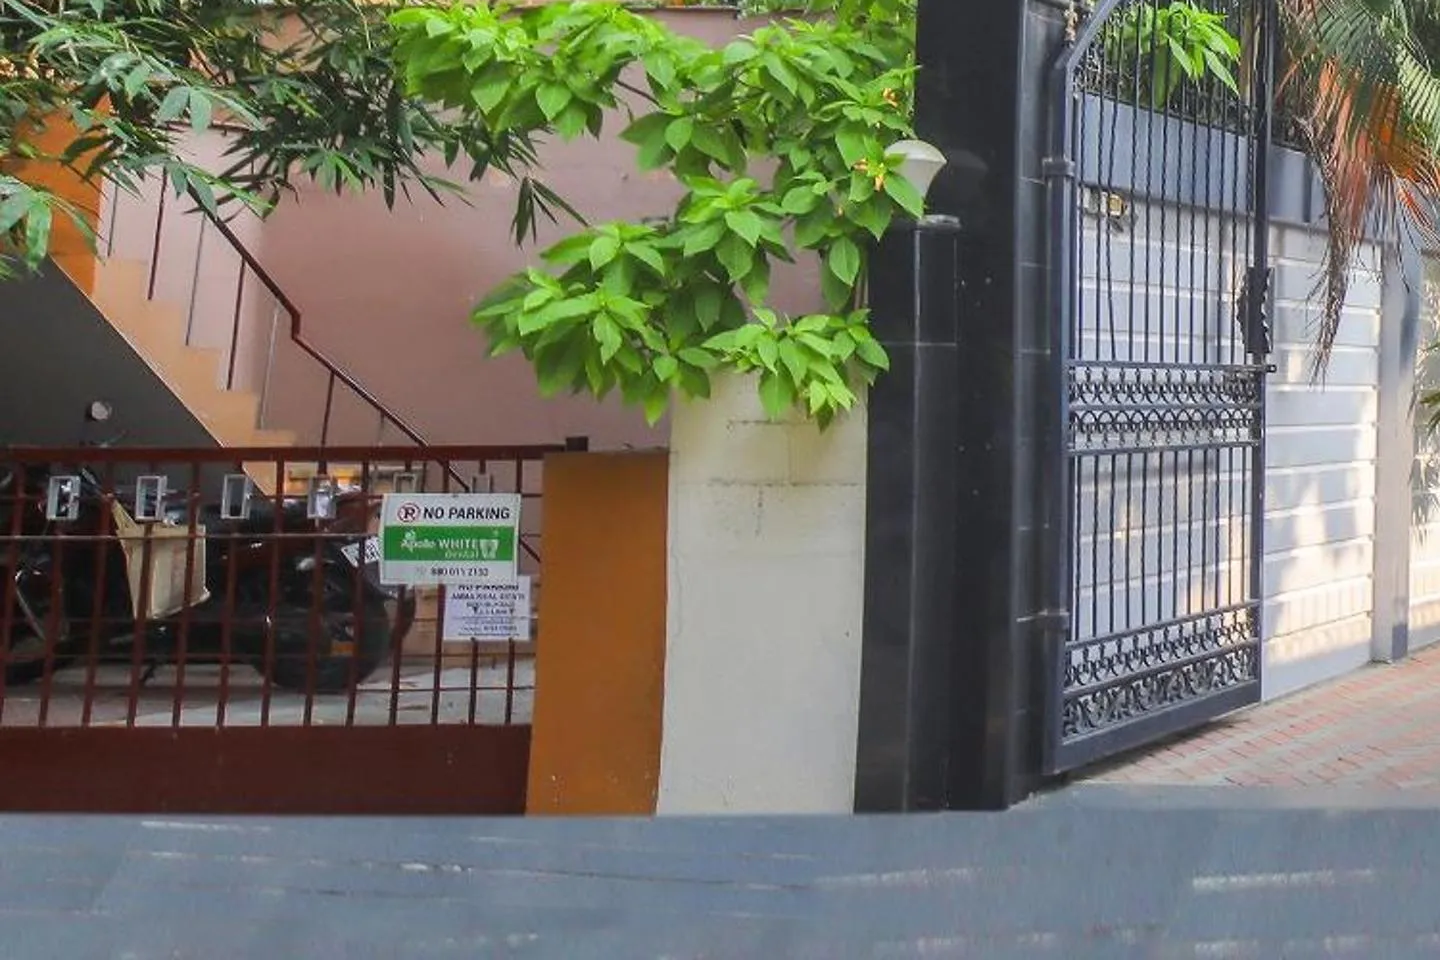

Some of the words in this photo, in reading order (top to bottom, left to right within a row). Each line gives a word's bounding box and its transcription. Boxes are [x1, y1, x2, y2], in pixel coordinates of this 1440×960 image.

[423, 507, 445, 519] NO
[448, 507, 510, 519] PARKING
[438, 539, 478, 549] WHITE
